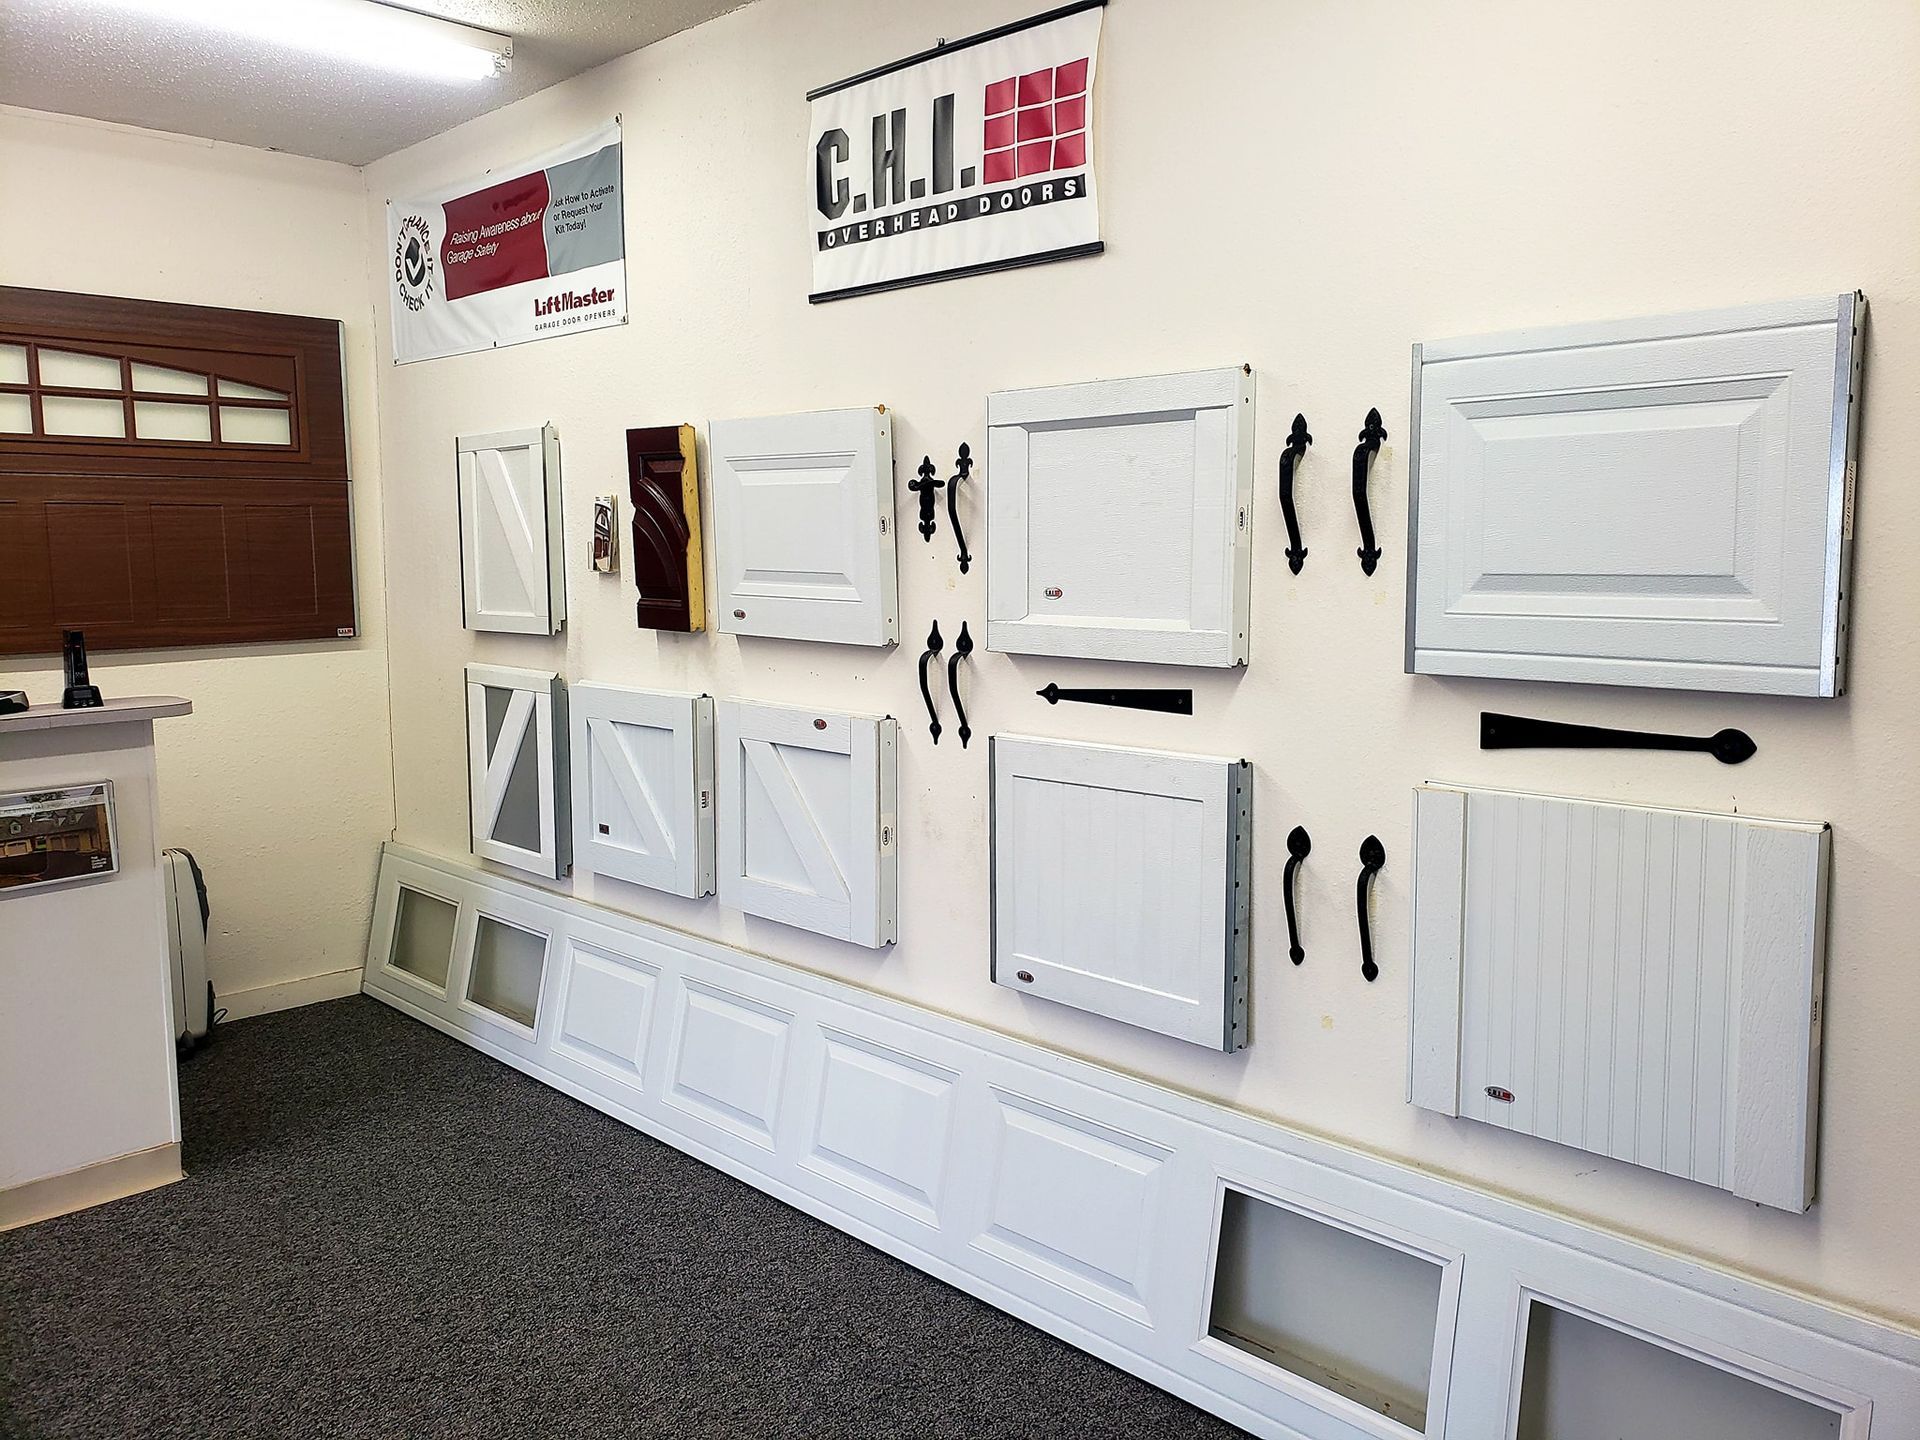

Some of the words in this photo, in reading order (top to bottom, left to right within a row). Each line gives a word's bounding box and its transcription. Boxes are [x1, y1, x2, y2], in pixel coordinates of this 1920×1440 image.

[816, 93, 976, 221] C.H.I.
[564, 195, 580, 205] How
[581, 192, 589, 201] to
[589, 184, 615, 199] Activate
[449, 229, 479, 245] Raising
[478, 217, 520, 239] Awareness
[519, 207, 543, 227] about
[553, 213, 560, 221] or
[561, 205, 589, 219] Request
[589, 202, 603, 212] Your
[554, 224, 565, 235] Kit
[565, 218, 587, 232] Today!
[826, 203, 959, 247] OVERHEAD
[979, 178, 1078, 214] DOORS
[402, 215, 431, 254] CHANCE
[427, 257, 434, 275] IT
[446, 249, 474, 264] Garage
[474, 241, 500, 258] Safety
[399, 283, 425, 312] CHECK
[424, 279, 434, 300] IT
[534, 286, 615, 317] LiftMaster
[535, 320, 560, 331] GARAGE
[562, 315, 582, 326] DOOR
[583, 308, 616, 321] OPENERS
